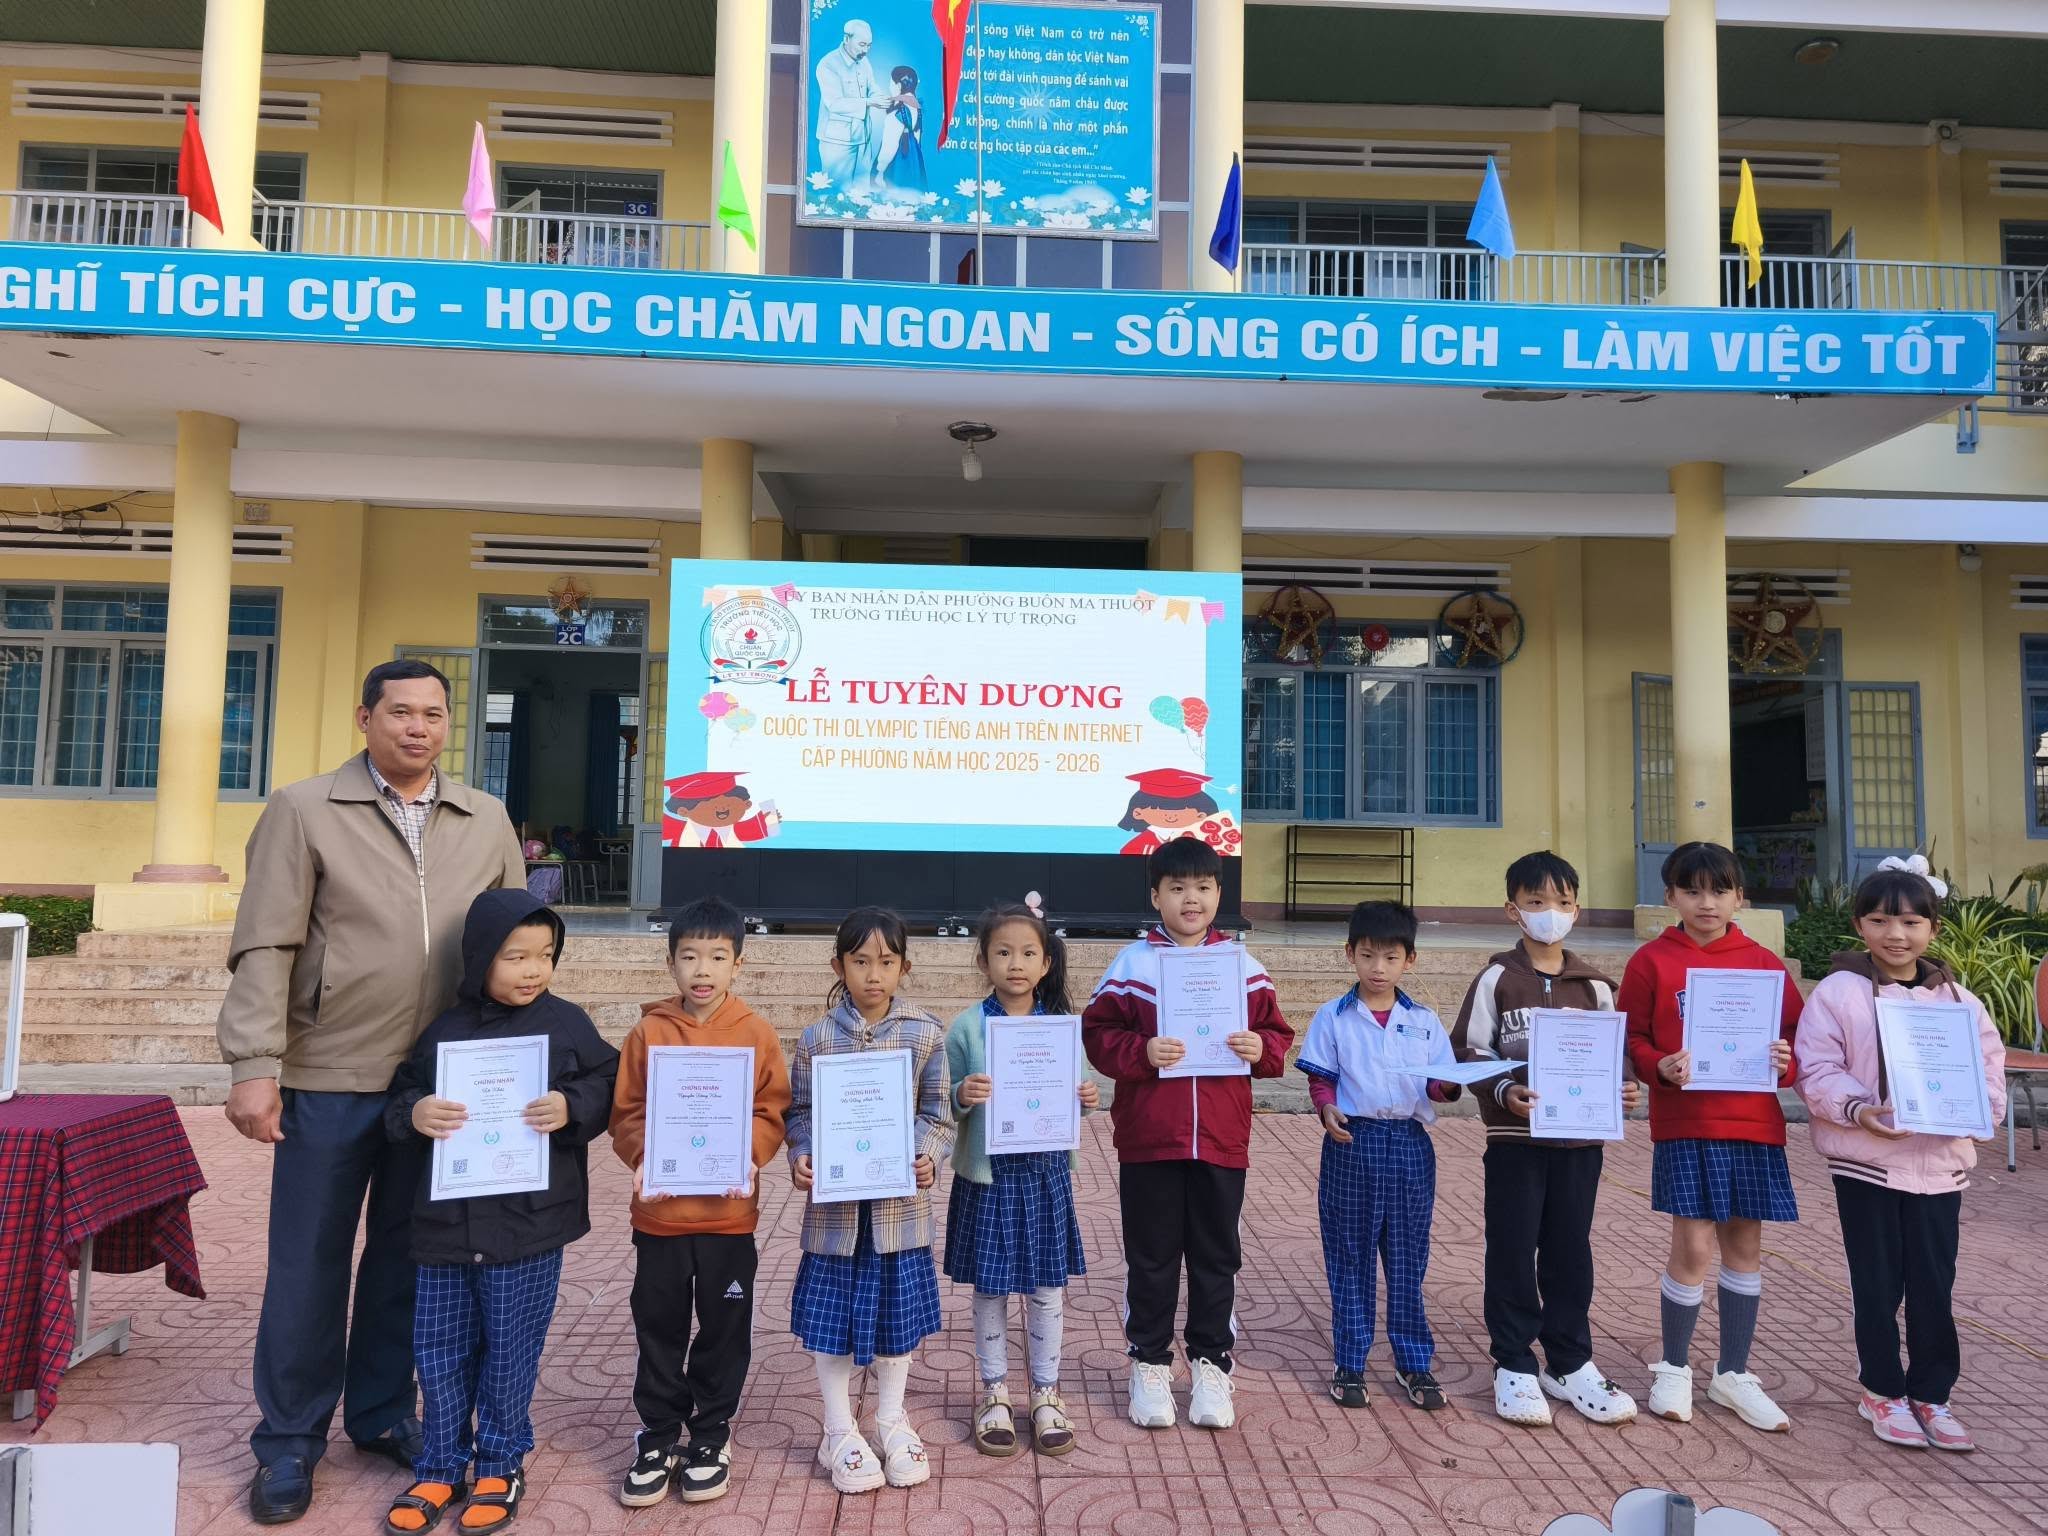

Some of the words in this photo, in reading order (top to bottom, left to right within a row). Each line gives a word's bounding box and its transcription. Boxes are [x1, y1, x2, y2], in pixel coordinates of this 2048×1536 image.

[984, 24, 1008, 39] sông
[1014, 24, 1035, 40] Việt
[1041, 26, 1065, 38] Nam
[1071, 28, 1083, 39] có
[1110, 29, 1130, 41] nên
[987, 45, 1006, 60] hay
[1008, 47, 1043, 64] không,
[1067, 49, 1082, 64] tộc
[1084, 50, 1104, 66] Việt
[1106, 51, 1129, 64] Nam
[1000, 69, 1015, 83] đài
[1040, 74, 1072, 88] quang
[1089, 74, 1112, 86] sánh
[1115, 76, 1129, 88] vai
[983, 93, 1015, 108] cường
[1019, 94, 1044, 109] quốc
[1049, 96, 1071, 108] năm
[1075, 97, 1099, 109] châu
[1104, 98, 1129, 114] được
[1006, 117, 1033, 130] chính
[1039, 118, 1048, 130] là
[1078, 120, 1098, 136] một
[995, 141, 1014, 157] học
[1015, 141, 1032, 156] tập
[1034, 141, 1051, 154] của
[1053, 144, 1069, 156] các
[628, 203, 647, 215] 3C
[120, 264, 265, 318] TÍCH
[287, 275, 417, 332] CỰC
[485, 286, 612, 341] HỌC
[634, 289, 818, 344] CHĂM
[840, 303, 1051, 353] NGOAN
[1114, 301, 1279, 360] SỐNG
[1300, 312, 1379, 363] CÓ
[1399, 314, 1499, 368] ÍCH
[1563, 320, 1690, 372] LÀM
[1709, 323, 1842, 382] VIỆC
[1861, 319, 1966, 376] TỐT
[812, 591, 846, 603] BAN
[851, 589, 899, 604] NHÂN
[904, 590, 939, 606] DÂN
[944, 592, 1014, 608] PHƯỜNG
[1019, 593, 1065, 609] BUÔN
[1069, 597, 1096, 610] MA
[1099, 595, 1156, 612] THUỘT
[810, 606, 880, 621] TRƯỜNG
[927, 610, 962, 624] HỌC
[967, 609, 988, 623] LÝ
[992, 611, 1016, 626] TỰ
[1020, 612, 1077, 627] TRỌNG
[558, 632, 582, 645] 2C
[561, 624, 578, 632] LỚP
[785, 667, 831, 703] LỄ
[841, 674, 968, 706] TUYÊN
[978, 683, 1123, 709] DƯƠNG
[763, 713, 808, 740] CUỘC
[813, 718, 839, 737] THI
[844, 718, 918, 740] OLYMPIC
[923, 714, 970, 740] TIẾNG
[975, 720, 1011, 740] ANH
[1015, 718, 1059, 742] TRÊN
[1063, 722, 1144, 744] INTERNET
[802, 744, 836, 768] CẤP
[840, 746, 908, 769] PHƯỜNG
[913, 746, 952, 769] NĂM
[957, 751, 990, 774] HỌC
[995, 752, 1039, 772] 2025
[1056, 753, 1100, 773] 2026
